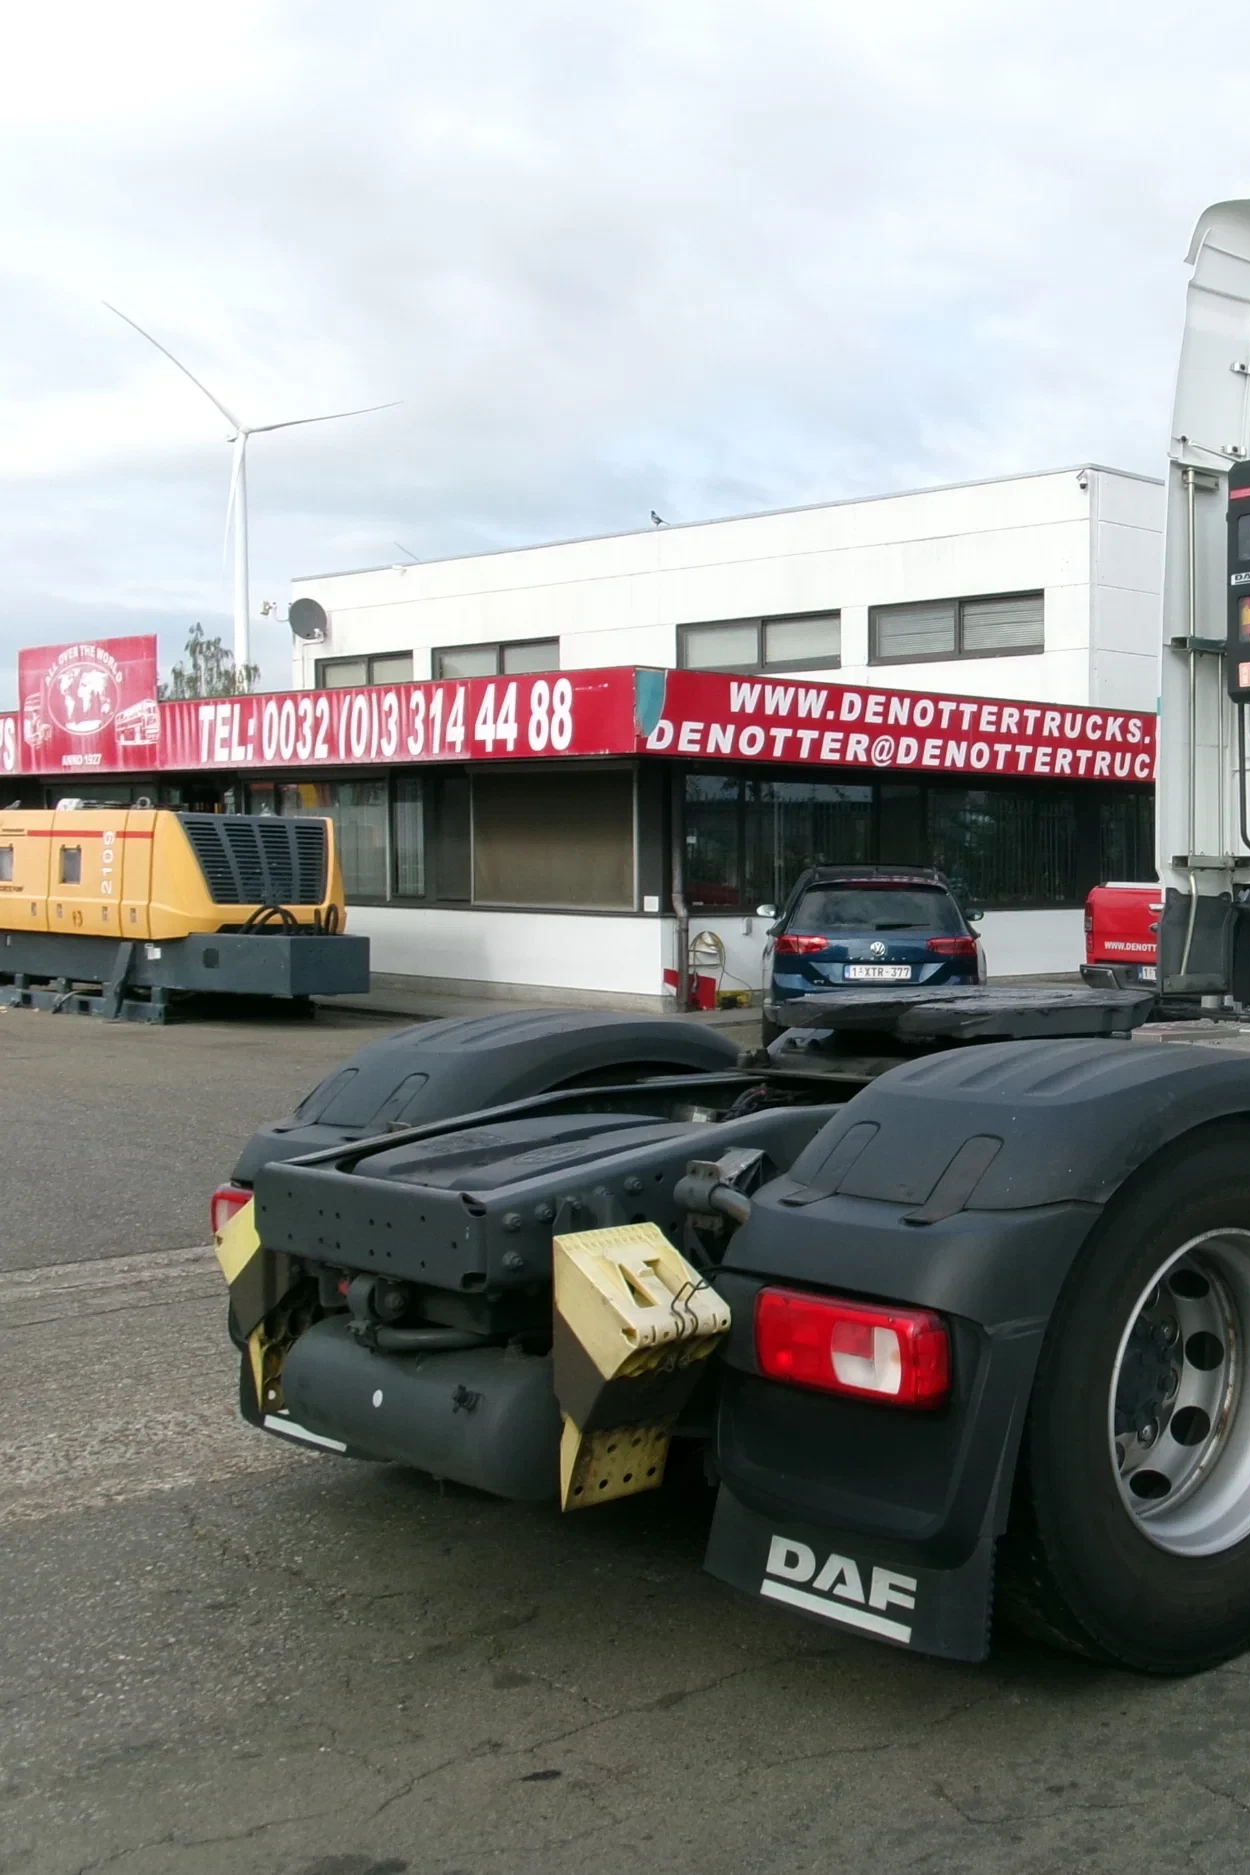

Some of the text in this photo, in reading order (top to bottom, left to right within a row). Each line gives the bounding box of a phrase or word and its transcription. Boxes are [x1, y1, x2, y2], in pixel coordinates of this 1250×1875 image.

[58, 646, 79, 665] OVER
[79, 645, 96, 657] THE
[96, 646, 123, 683] WORLD
[198, 677, 573, 762] TEL: 0032 (0)3 314 44 88
[61, 753, 102, 766] ANNO 1927
[765, 1534, 918, 1611] DAF
